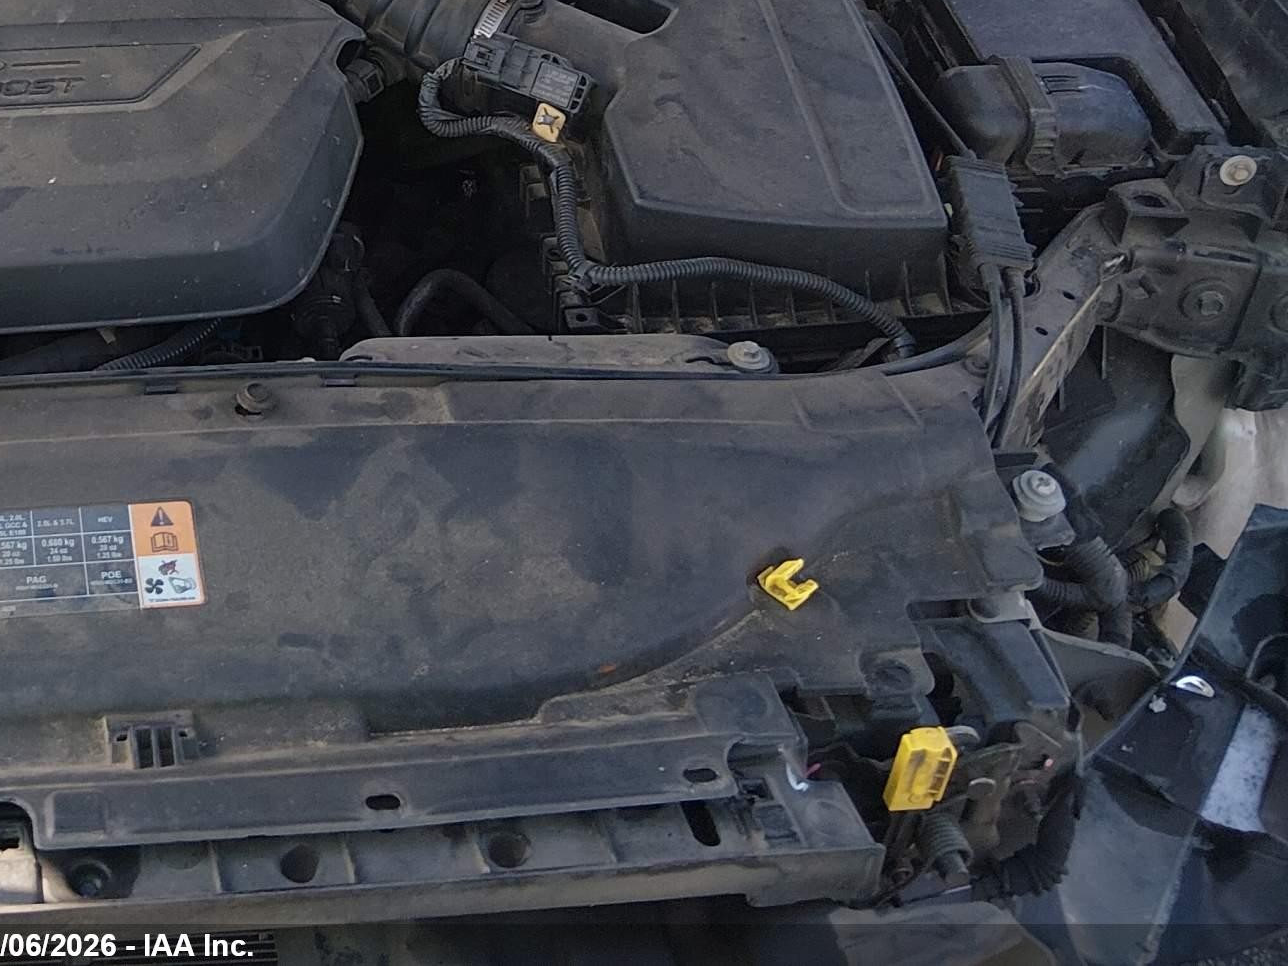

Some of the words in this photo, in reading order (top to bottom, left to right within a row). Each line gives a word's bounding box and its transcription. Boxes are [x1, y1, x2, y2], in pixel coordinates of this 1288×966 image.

[63, 538, 75, 548] kg
[113, 535, 124, 544] kg
[16, 541, 27, 551] kg
[26, 575, 47, 584] PAG
[100, 571, 122, 579] POE
